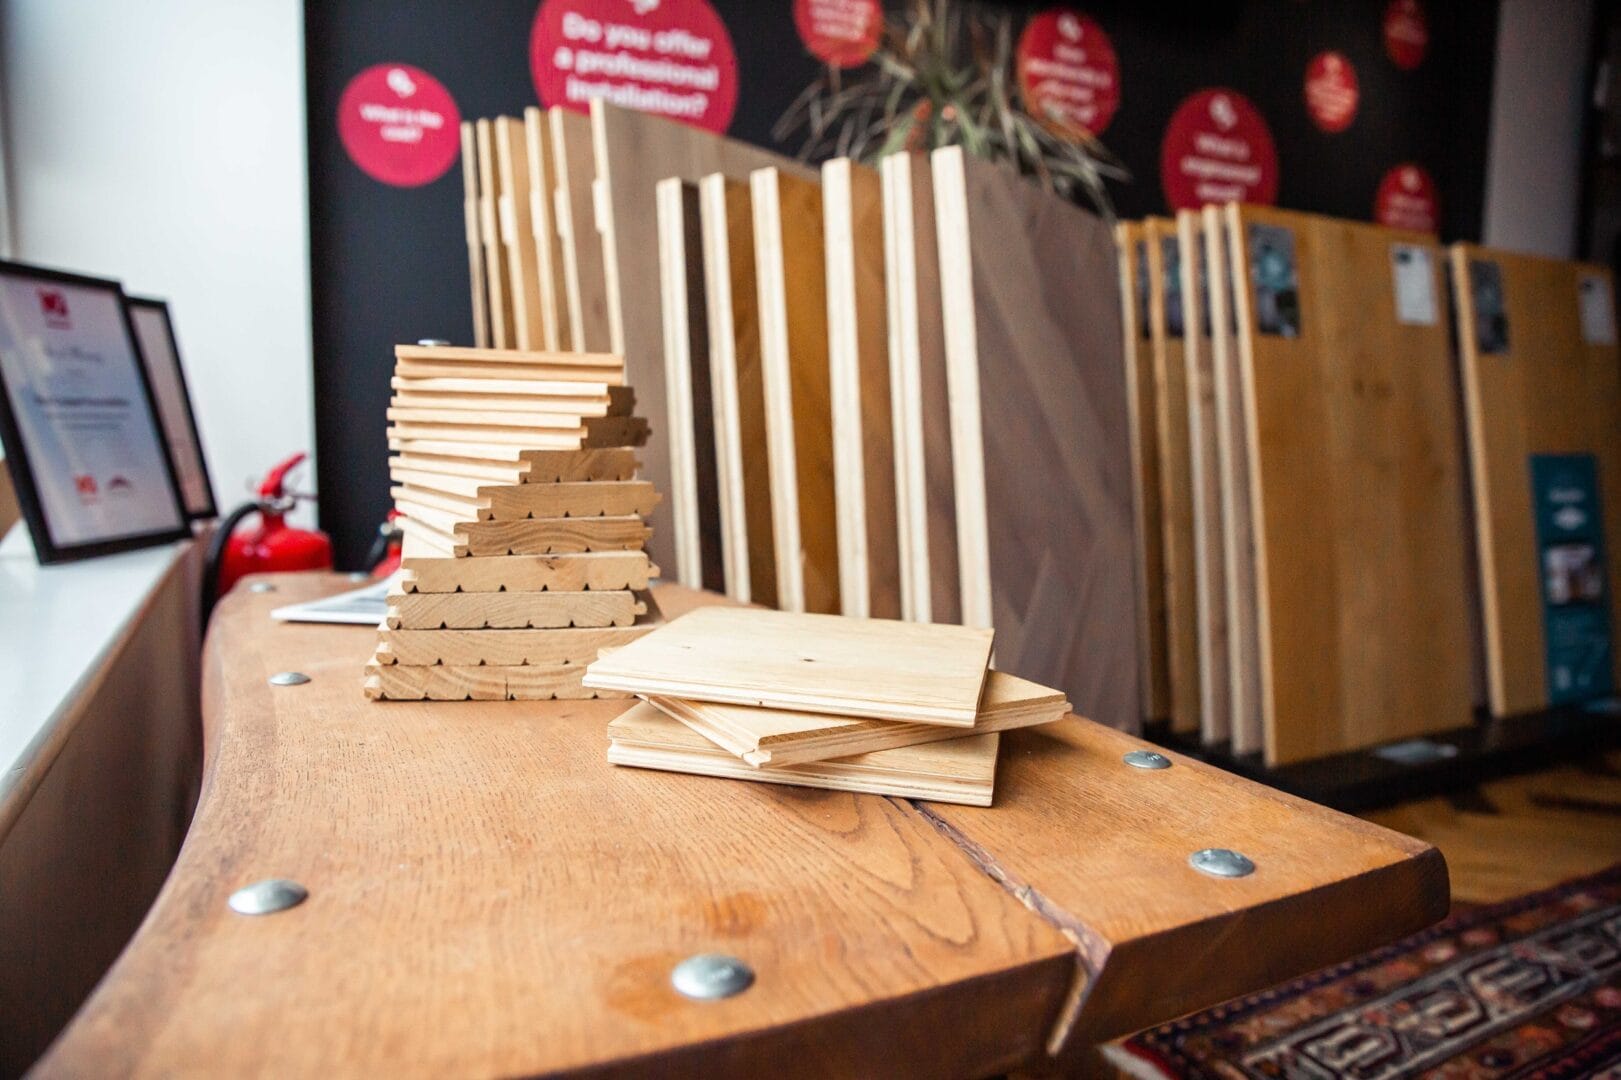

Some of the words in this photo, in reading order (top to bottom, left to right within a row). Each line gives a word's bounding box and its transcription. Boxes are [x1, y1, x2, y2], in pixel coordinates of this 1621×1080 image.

[563, 12, 602, 42] Do
[605, 23, 651, 50] you
[654, 29, 712, 58] offer
[554, 46, 573, 70] a
[575, 49, 719, 91] professional
